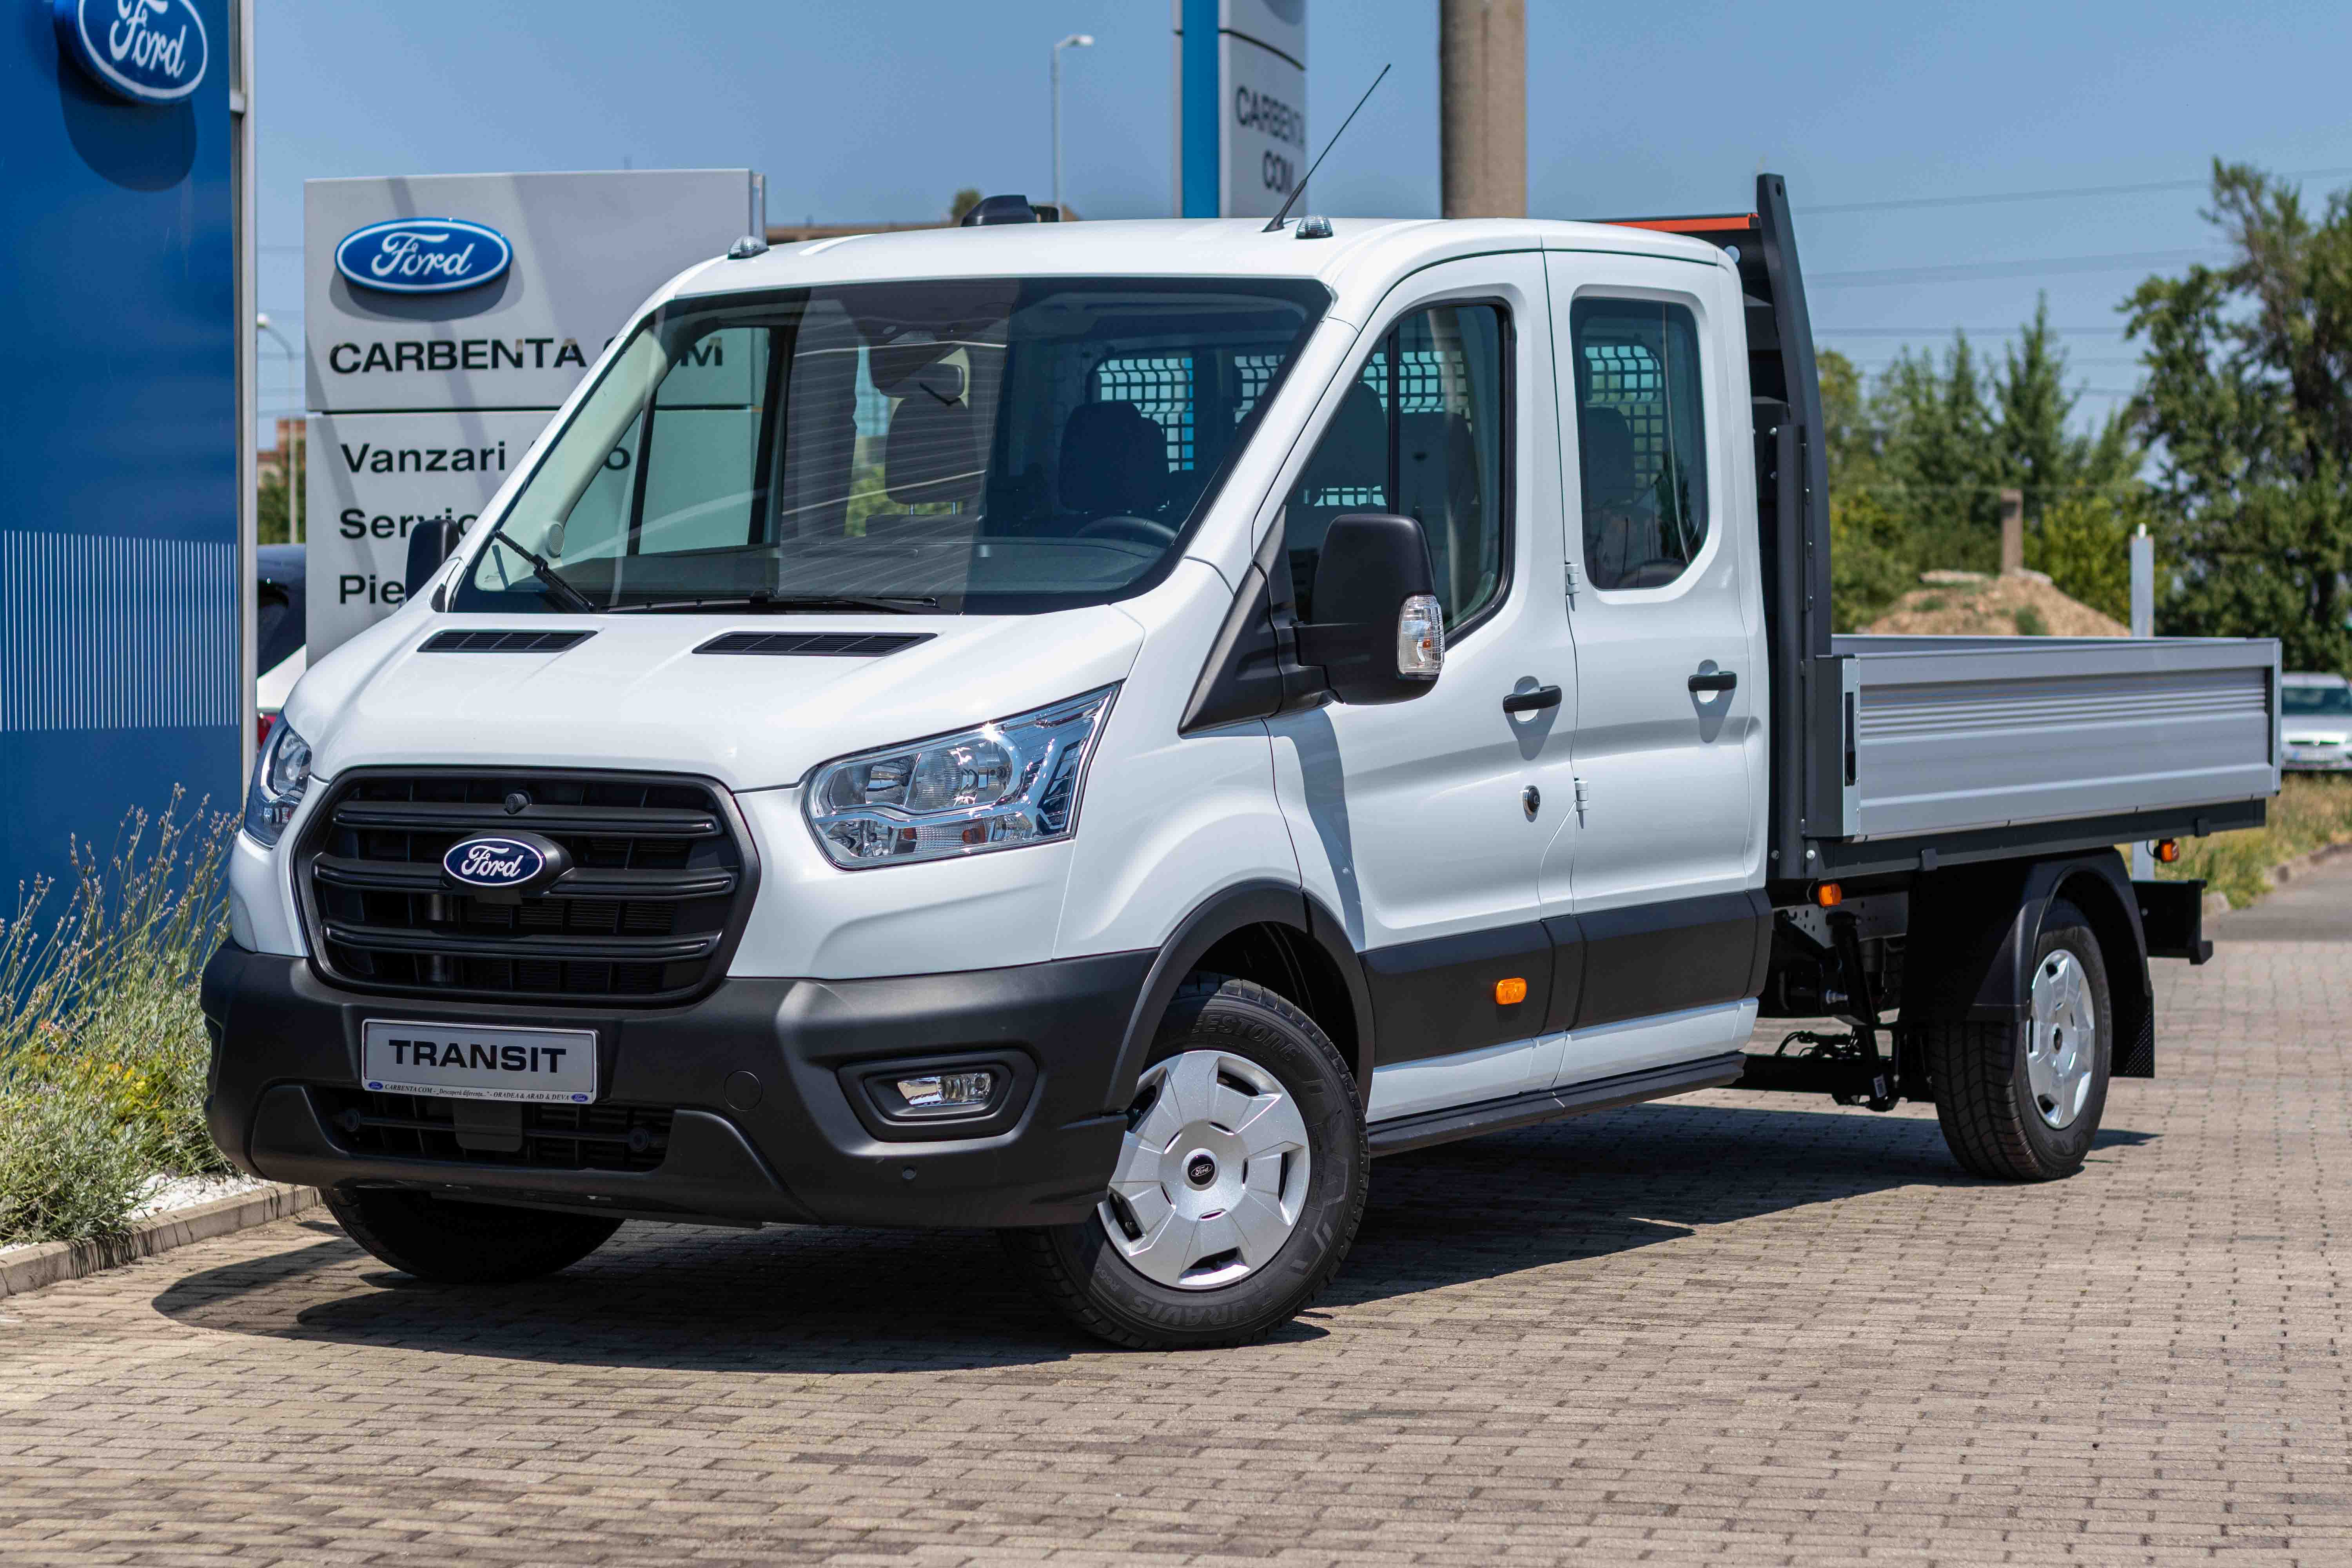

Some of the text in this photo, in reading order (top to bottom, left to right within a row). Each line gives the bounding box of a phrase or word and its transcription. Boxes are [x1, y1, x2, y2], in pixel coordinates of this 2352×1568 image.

[109, 0, 186, 78] Ford
[371, 232, 474, 276] Ford
[329, 338, 587, 374] CARBENTA
[340, 441, 506, 473] Vanzari
[461, 845, 524, 877] Ford
[388, 1039, 567, 1073] TRANSIT
[1195, 1166, 1209, 1175] Ford
